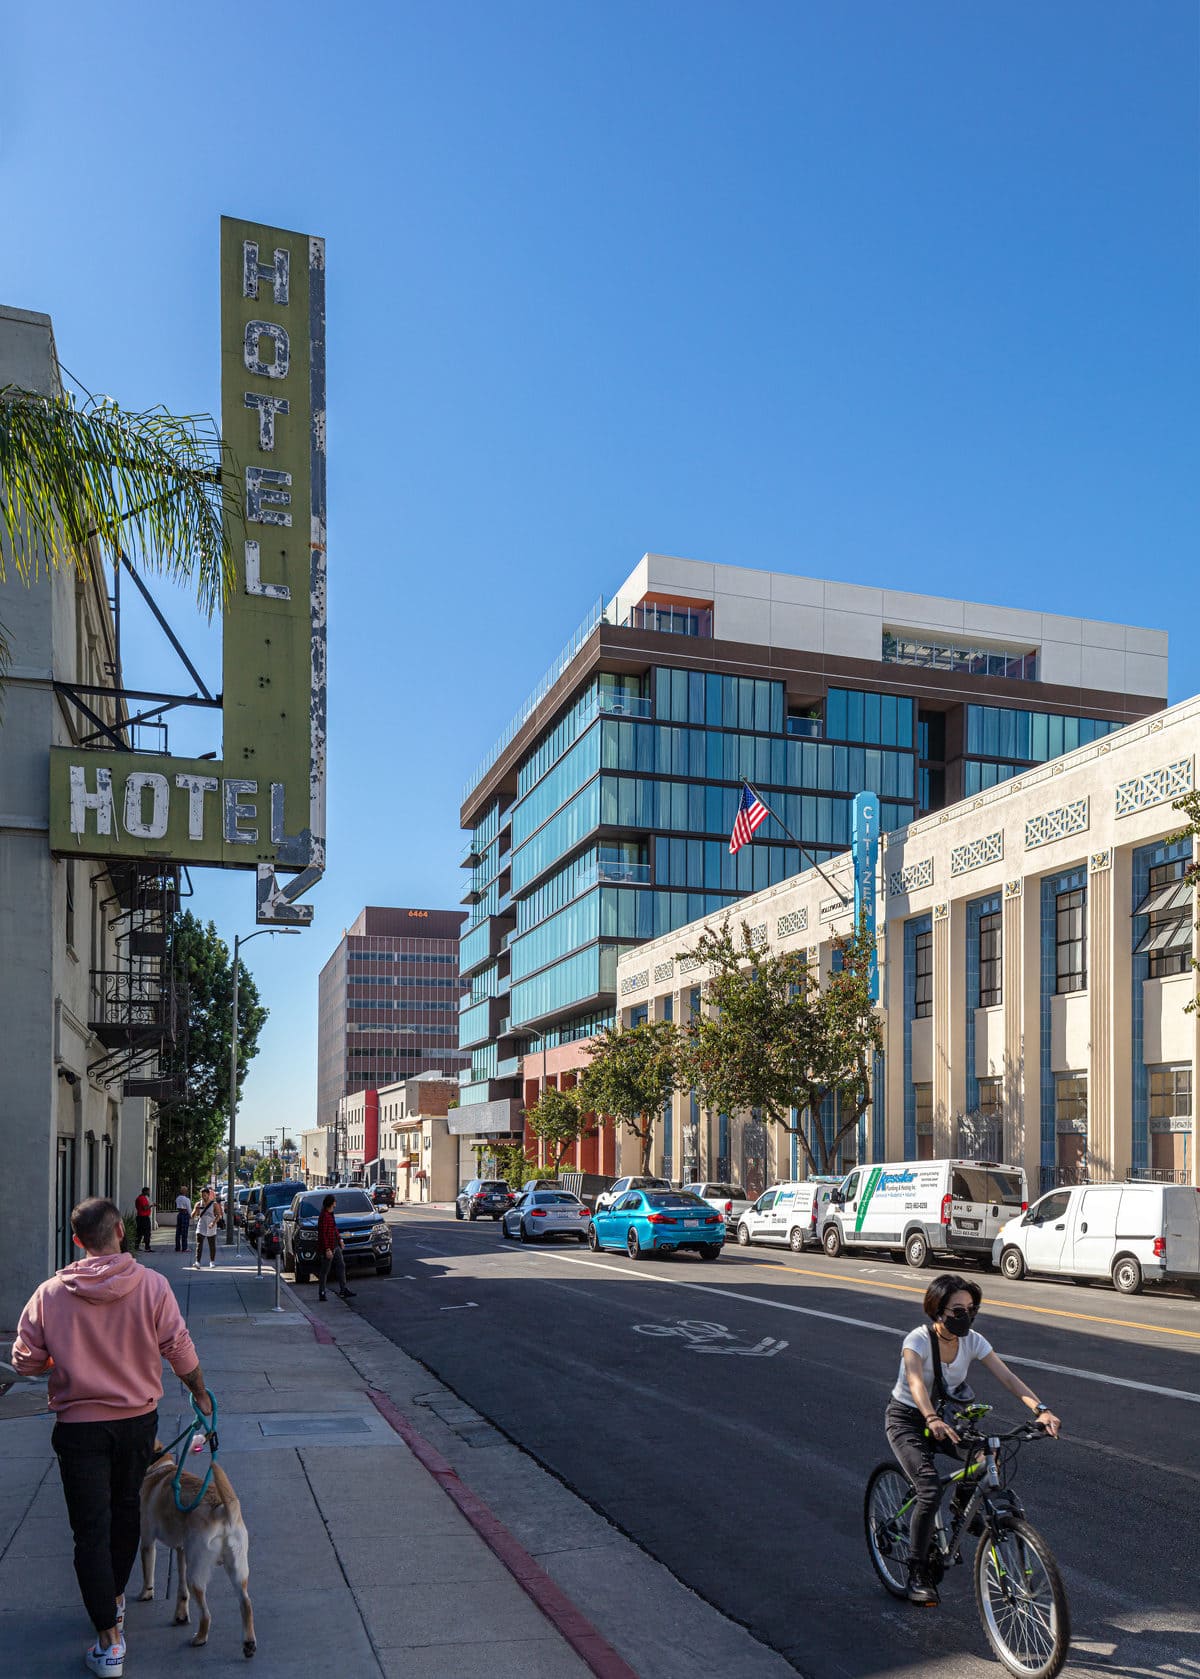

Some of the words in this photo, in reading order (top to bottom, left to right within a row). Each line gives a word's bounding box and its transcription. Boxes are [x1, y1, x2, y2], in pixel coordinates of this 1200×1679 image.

[243, 240, 292, 600] HOTEL
[69, 765, 290, 848] HOTEL
[863, 806, 874, 917] CITIZEN
[408, 910, 429, 918] 6464
